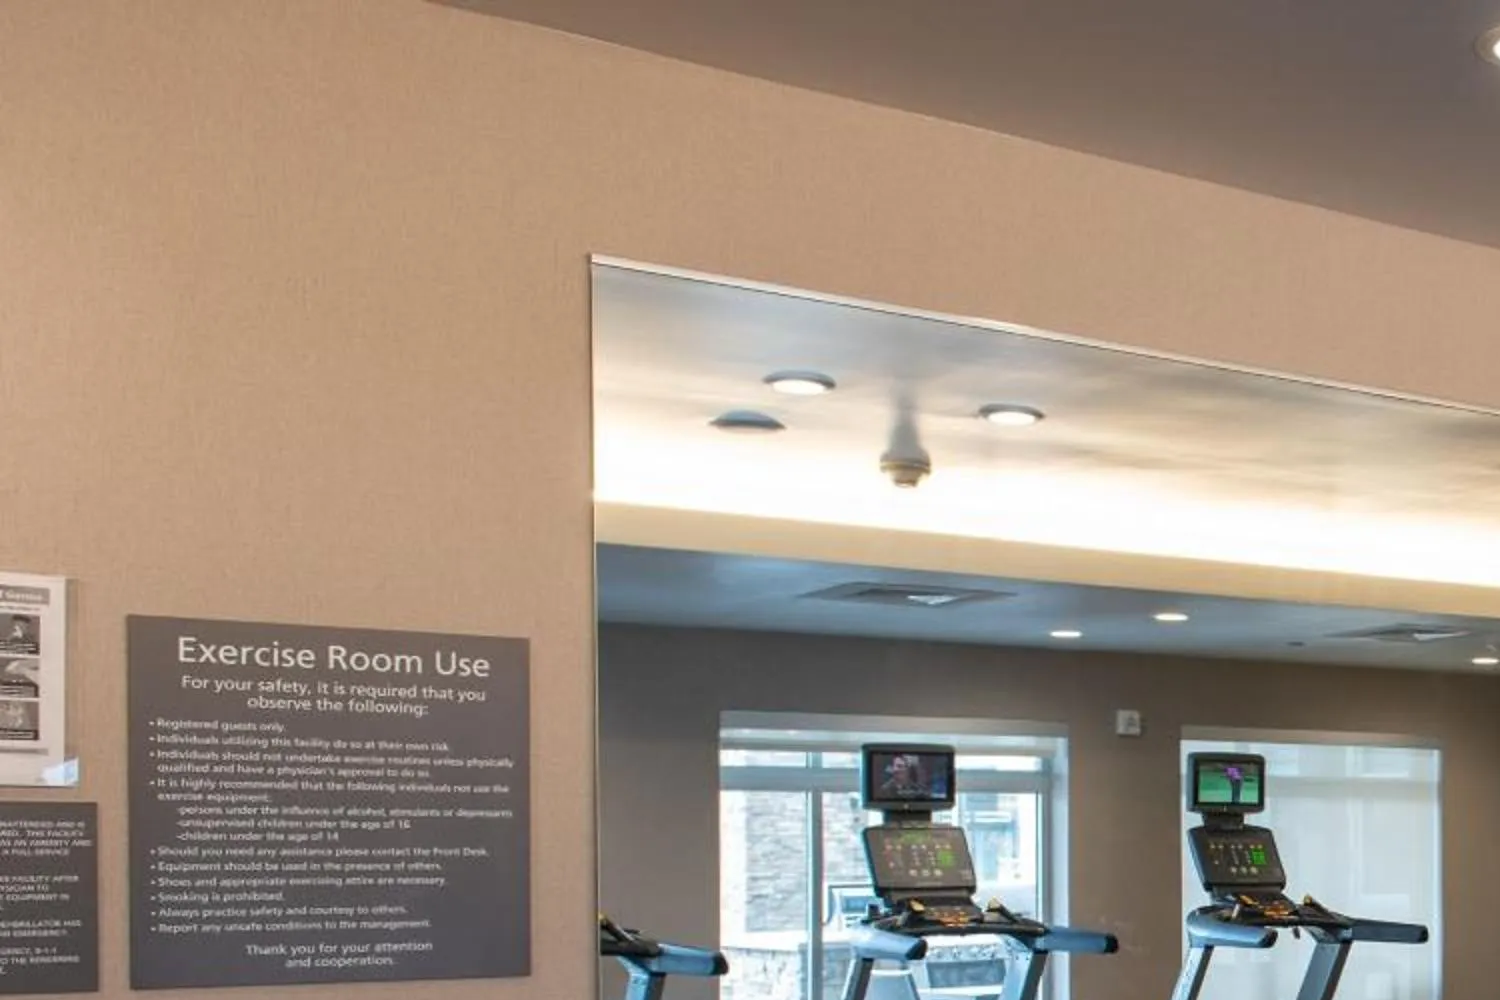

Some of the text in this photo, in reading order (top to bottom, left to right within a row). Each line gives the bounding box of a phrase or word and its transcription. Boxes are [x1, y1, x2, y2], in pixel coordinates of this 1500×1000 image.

[178, 636, 490, 677] Exercise Room Use
[181, 674, 487, 704] For your safety, it is required that you
[247, 696, 429, 718] observe the following:
[245, 941, 434, 956] Thank you for your attention
[284, 957, 313, 969] and
